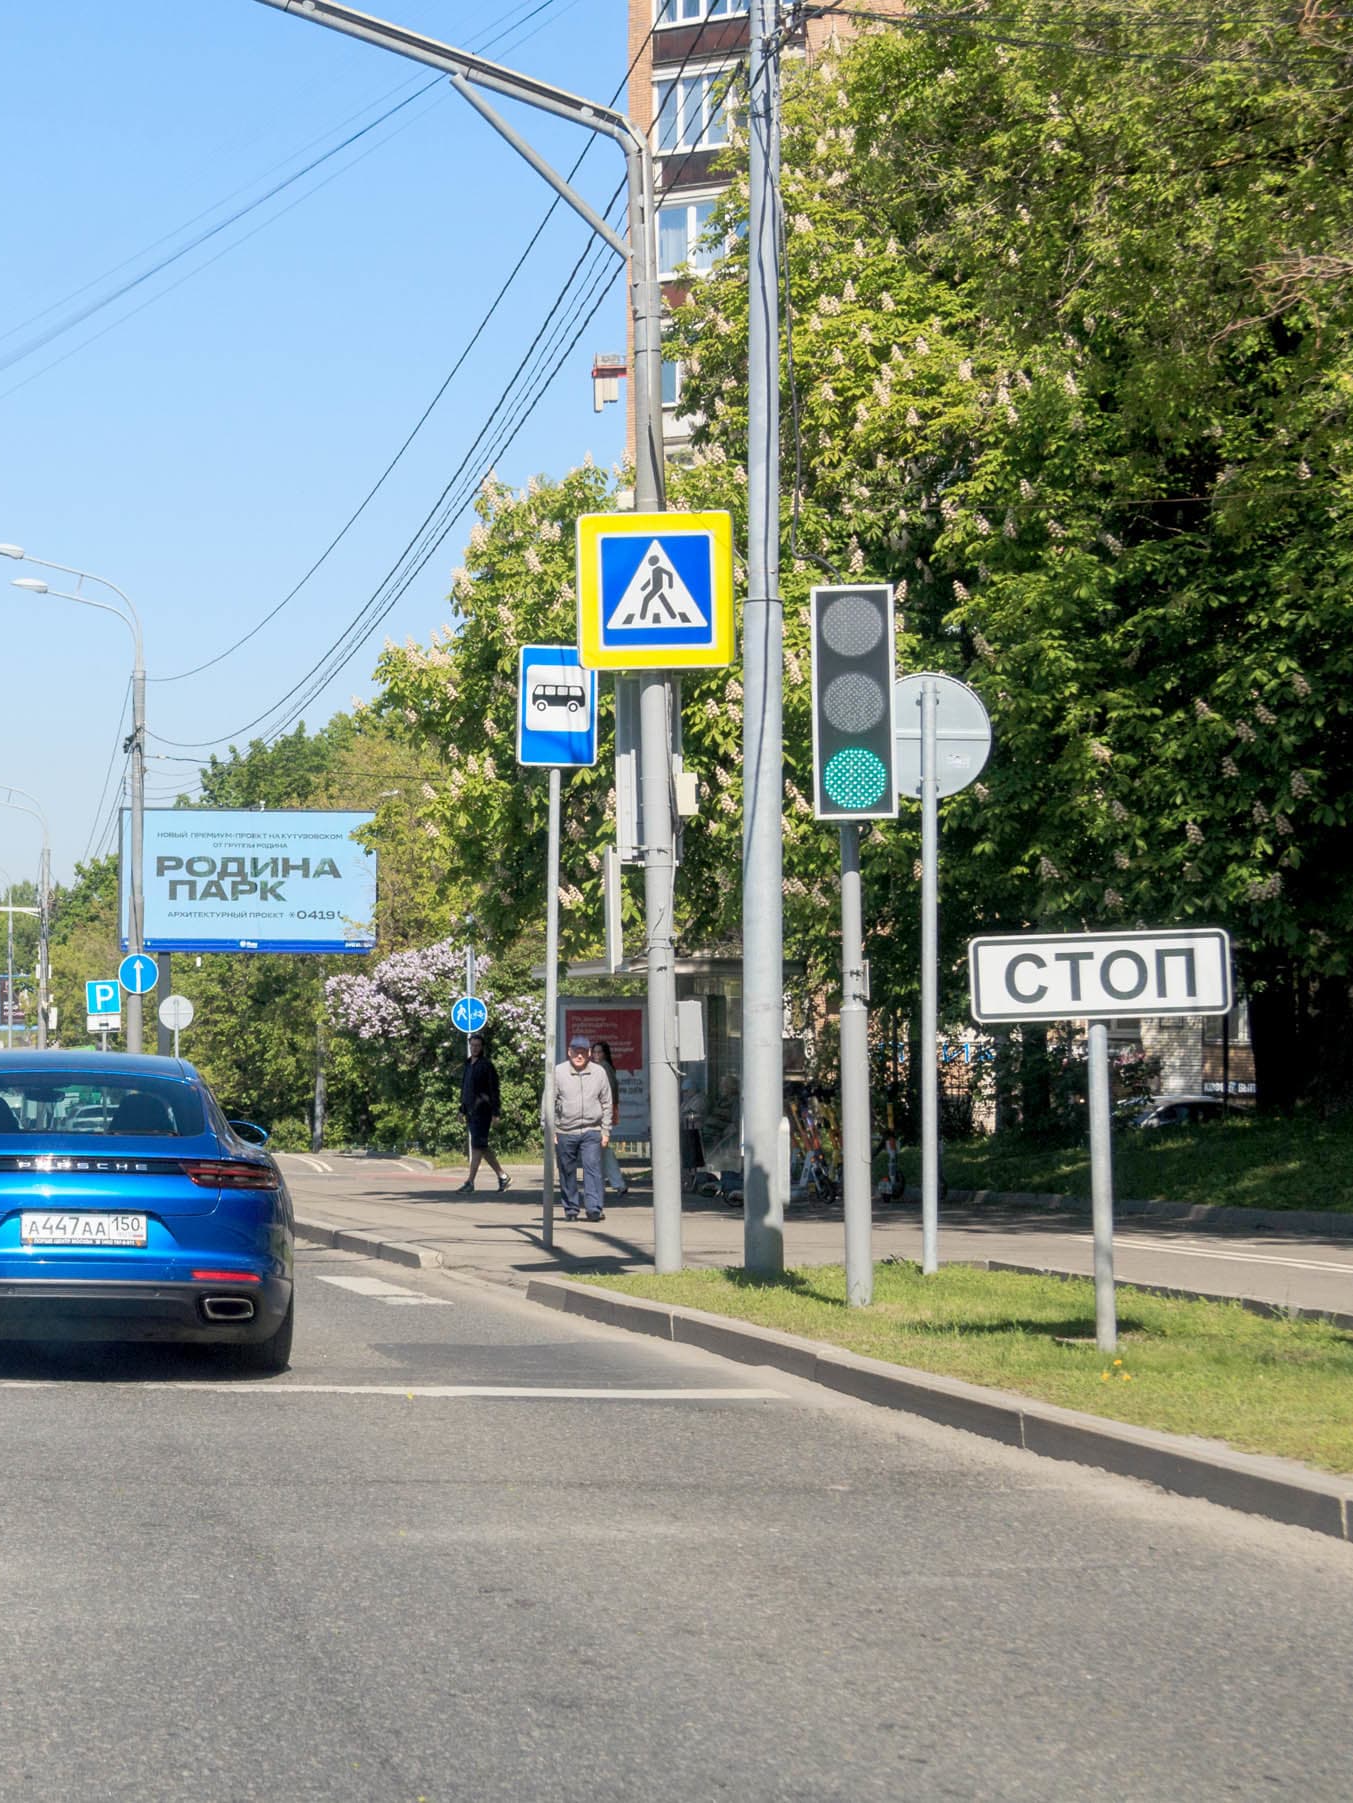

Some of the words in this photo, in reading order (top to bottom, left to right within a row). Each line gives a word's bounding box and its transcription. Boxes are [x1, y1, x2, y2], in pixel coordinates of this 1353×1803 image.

[157, 830, 188, 839] НОВЫЙ
[281, 833, 343, 841] КУТУЗОВСКОМ
[156, 856, 342, 881] РОДИНА
[168, 880, 286, 901] ПАРК
[168, 910, 248, 919] АРХИТЕКТУРНЫЙ
[1005, 948, 1197, 1004] СТОП
[96, 984, 114, 1011] P
[18, 1160, 148, 1171] PRSCHE
[112, 1215, 141, 1232] 150
